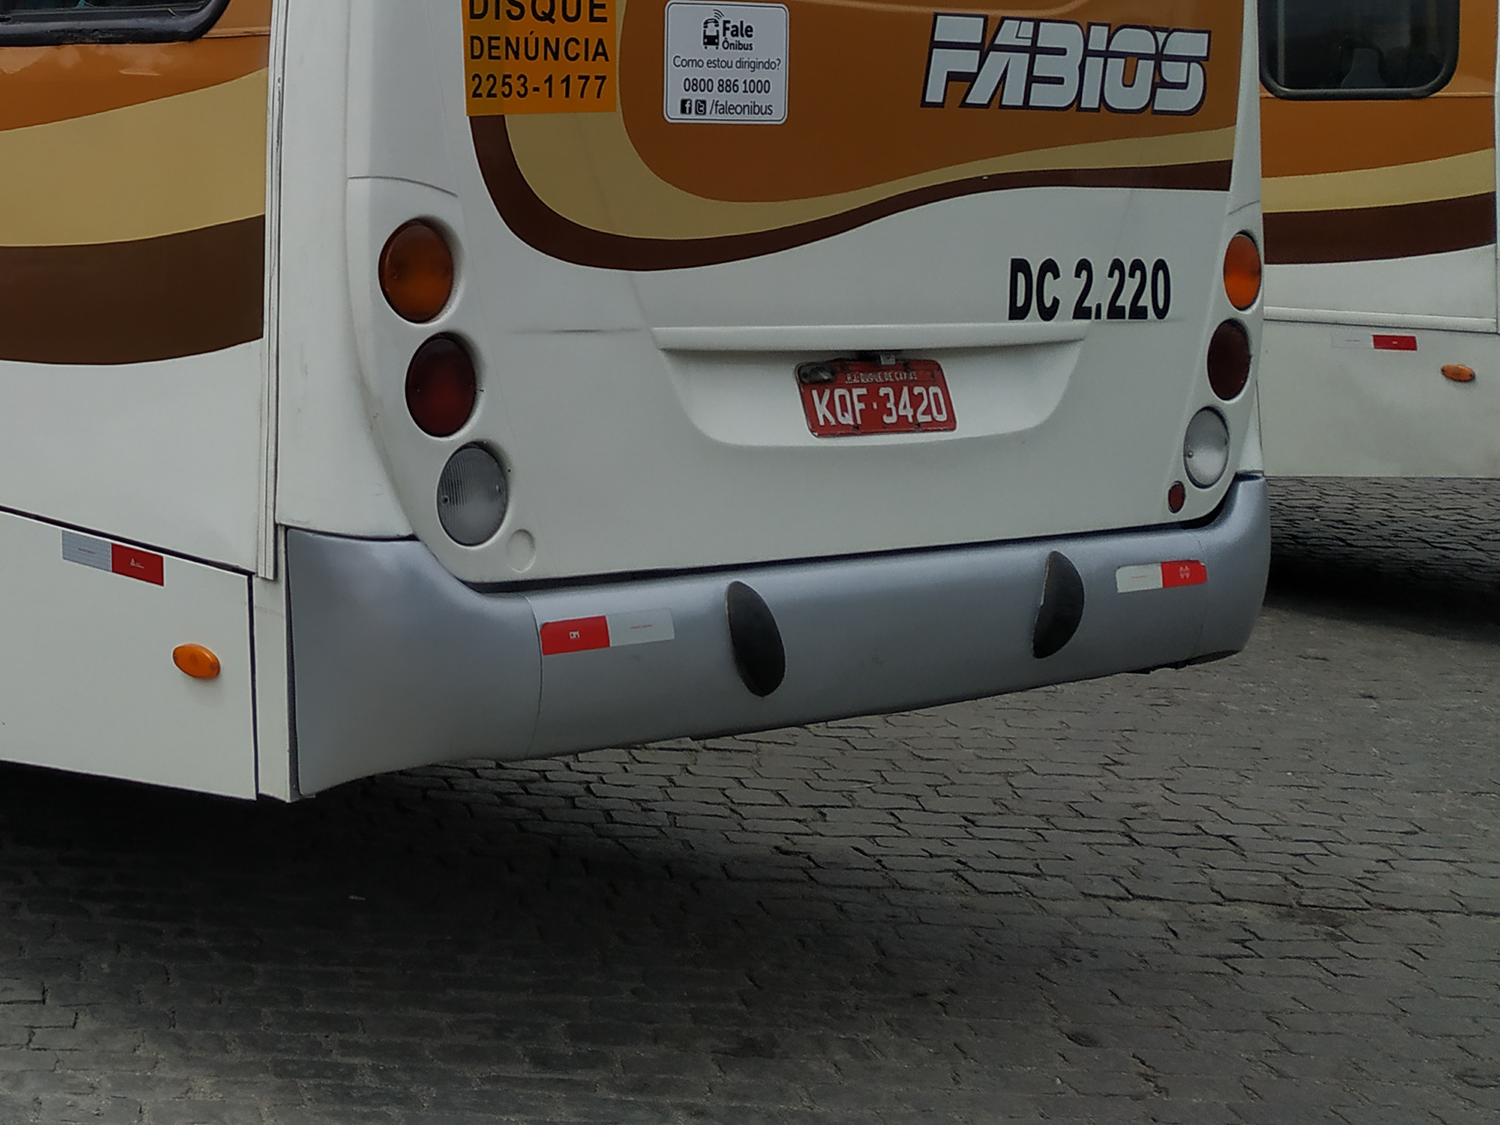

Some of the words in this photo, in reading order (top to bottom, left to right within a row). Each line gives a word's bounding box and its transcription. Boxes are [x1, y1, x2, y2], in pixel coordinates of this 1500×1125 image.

[722, 19, 754, 38] Fale
[470, 31, 610, 62] DENÚNCIA
[722, 38, 754, 51] Ônibus
[673, 55, 704, 68] Como
[706, 58, 733, 69] estou
[735, 57, 781, 72] dirigindo?
[471, 73, 607, 99] 2253-1177
[683, 78, 714, 92] 0800
[717, 78, 739, 93] 886
[742, 79, 771, 94] 1000
[709, 99, 773, 115] /faleonibus
[1008, 258, 1061, 321] DC
[1072, 258, 1171, 320] 2.220
